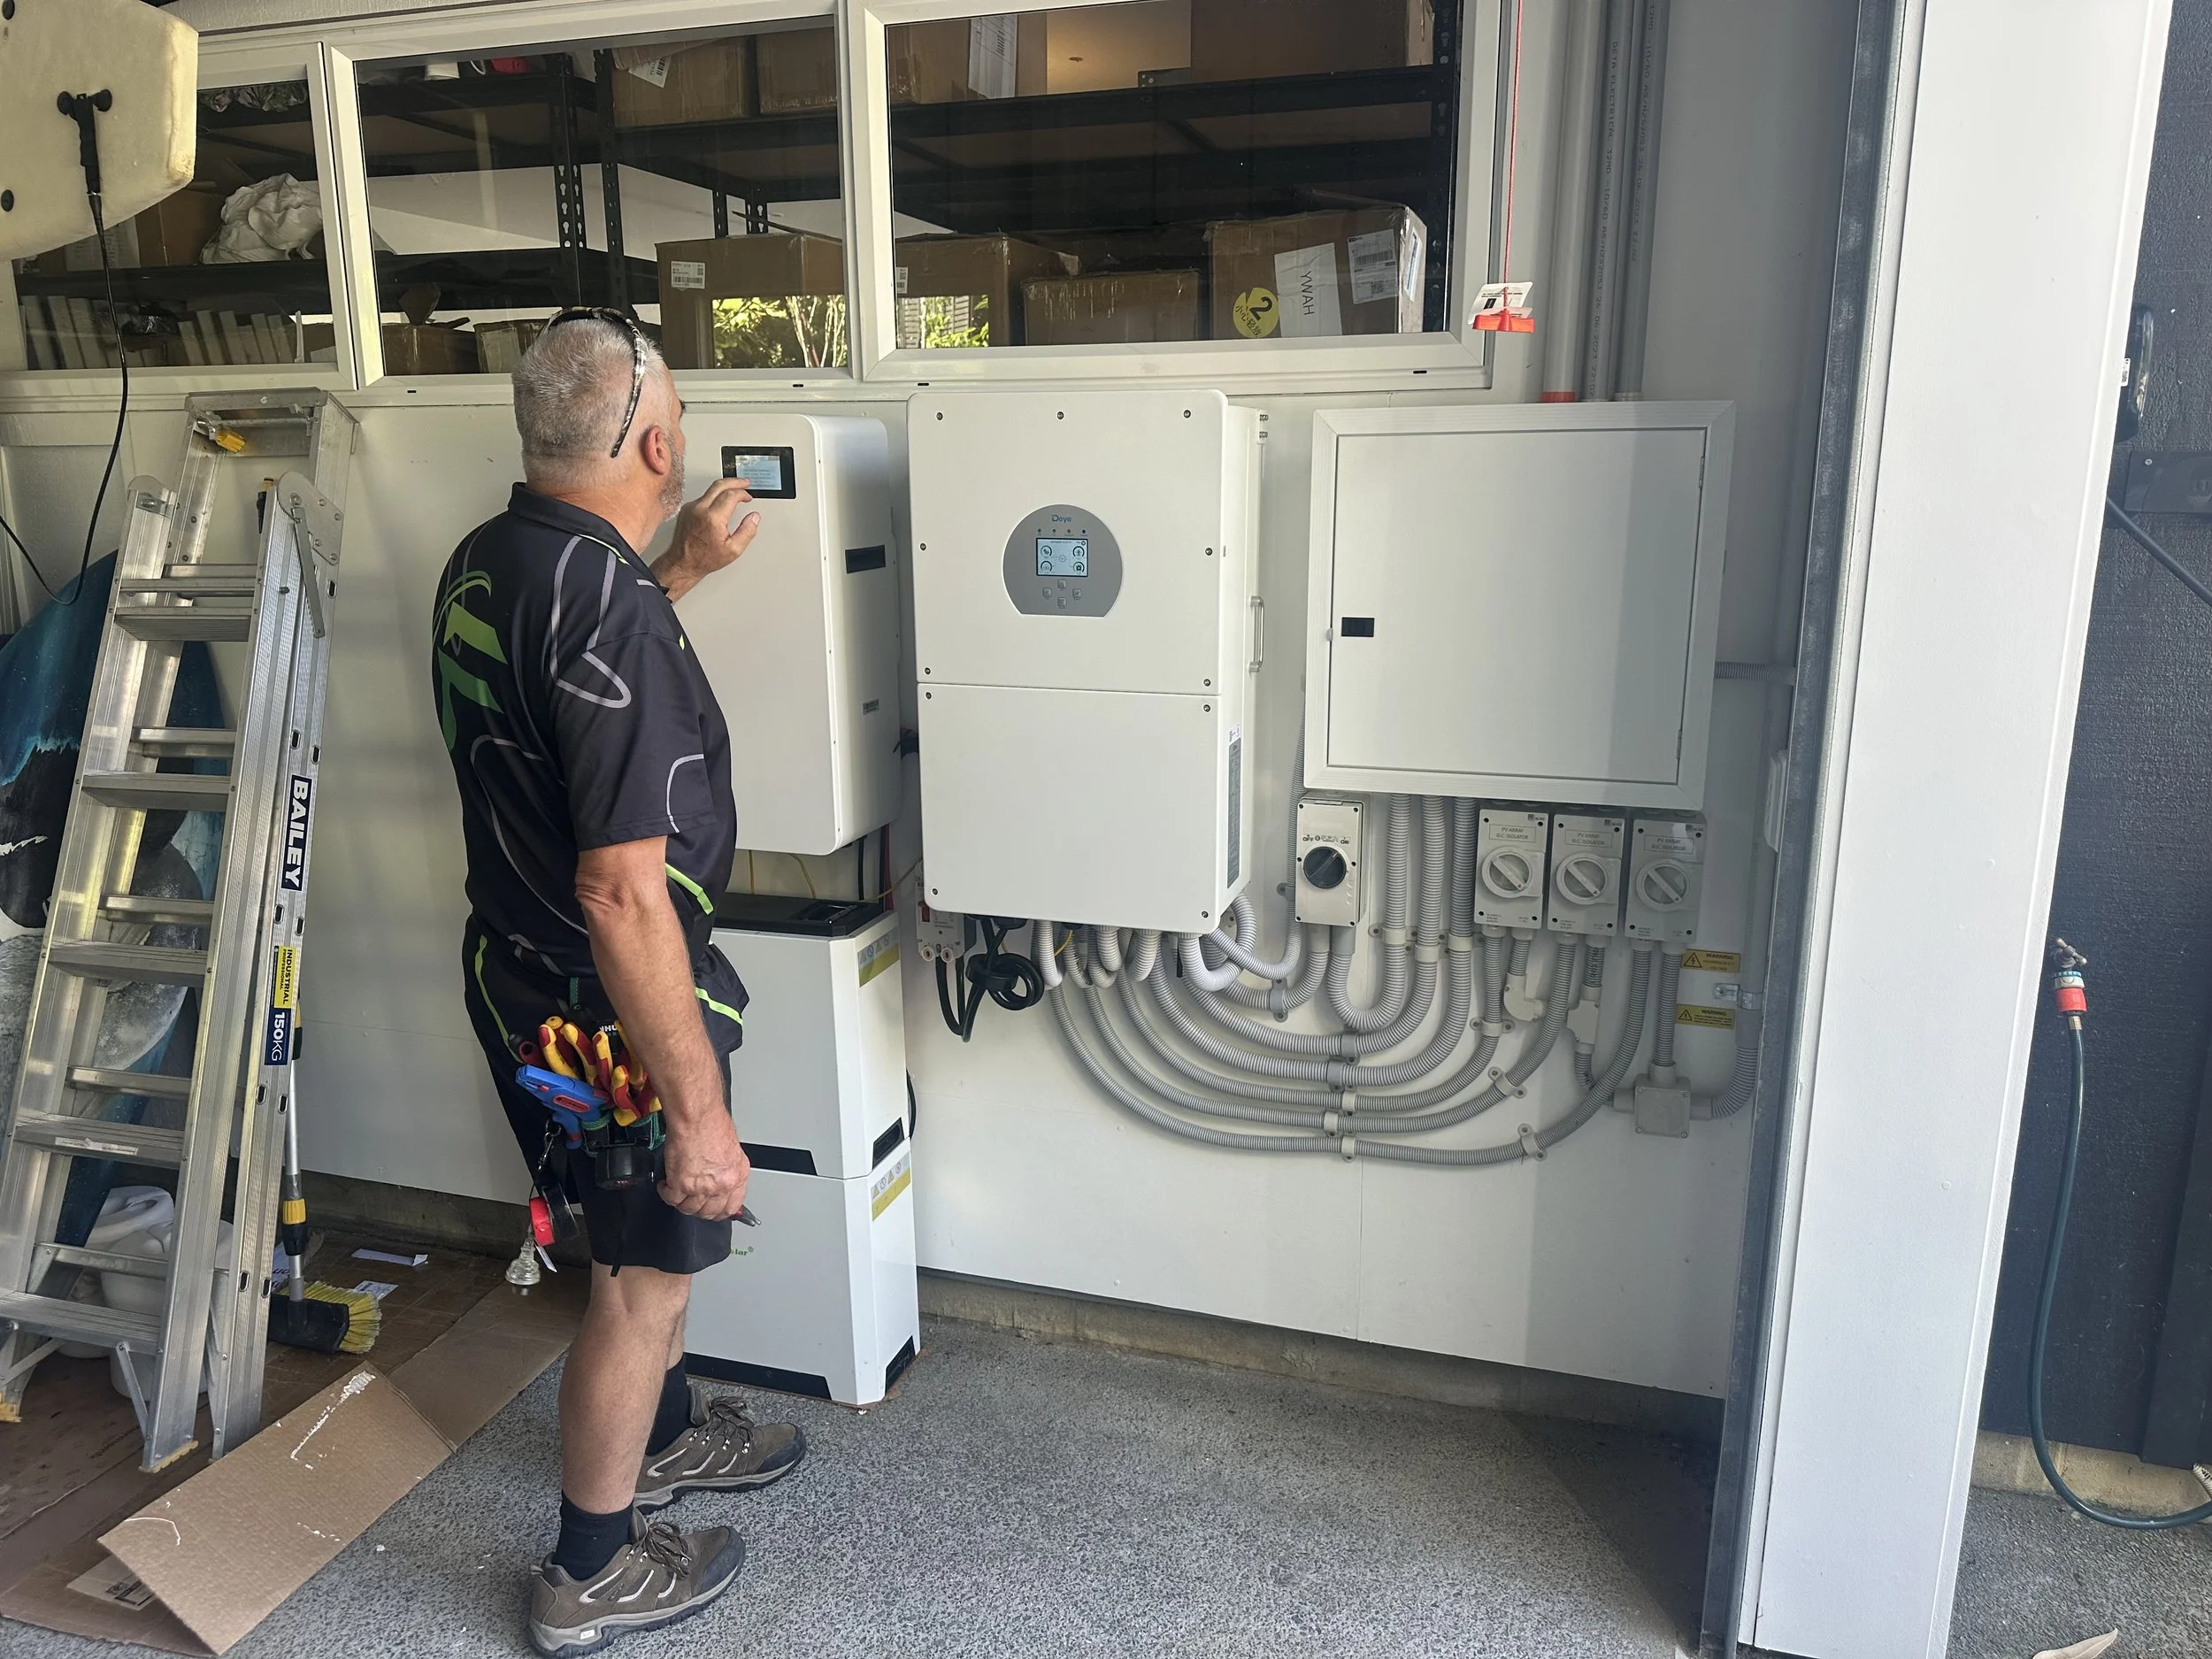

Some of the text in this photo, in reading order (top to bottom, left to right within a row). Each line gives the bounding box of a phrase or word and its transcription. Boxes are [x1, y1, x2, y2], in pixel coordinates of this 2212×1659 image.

[1249, 296, 1272, 321] 2
[1301, 271, 1315, 315] YWAH
[1235, 305, 1262, 336] 小心轻放
[1051, 514, 1071, 524] Deye
[285, 780, 309, 887] BAILEY
[283, 949, 293, 1004] INDUSTRIAL
[272, 1011, 286, 1061] 150KG
